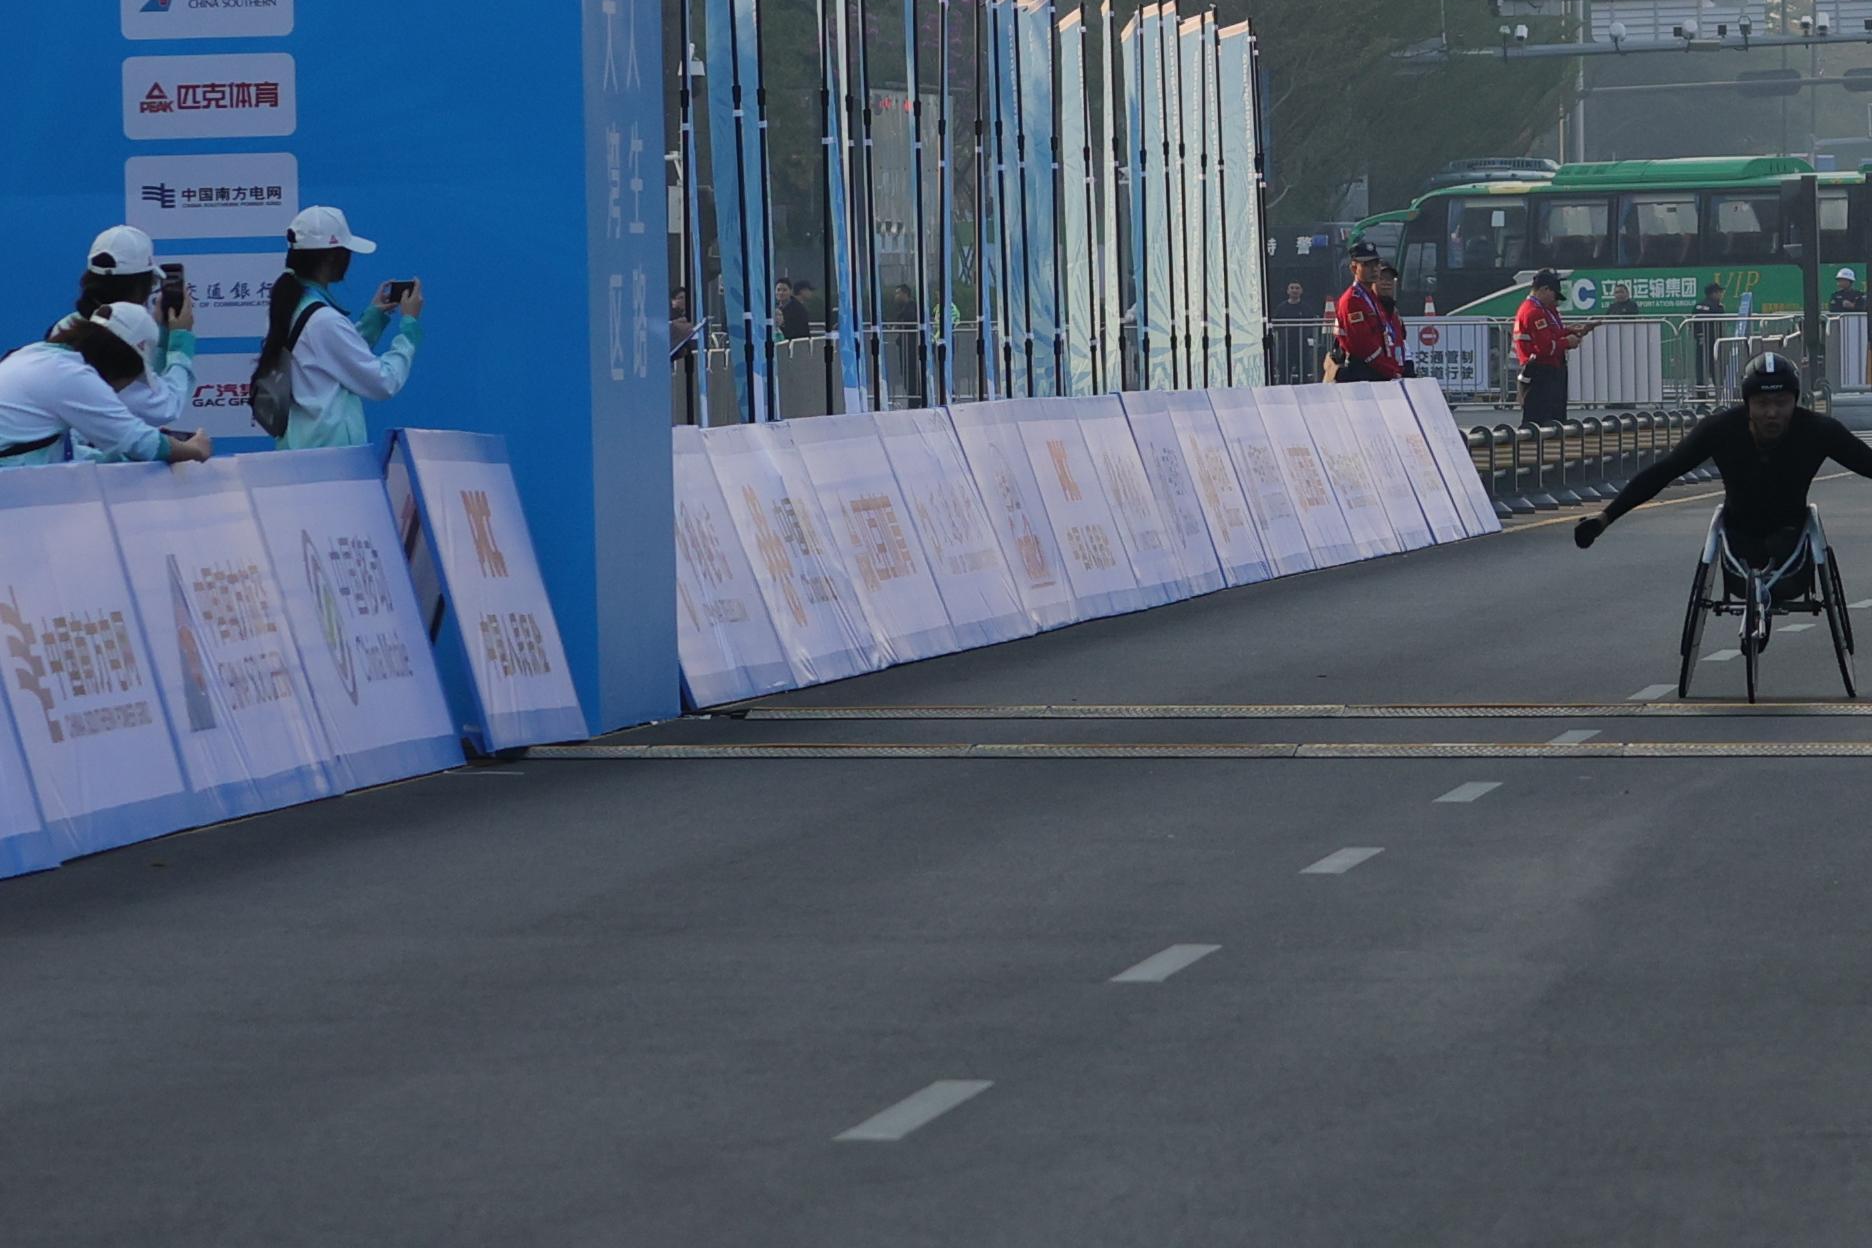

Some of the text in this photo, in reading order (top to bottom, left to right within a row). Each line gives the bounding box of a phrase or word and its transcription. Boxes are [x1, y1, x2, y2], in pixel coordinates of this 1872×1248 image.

[177, 82, 279, 109] 匹克体育
[140, 101, 174, 113] PEAK
[181, 186, 282, 201] 中国南方电网
[1714, 271, 1760, 298] VIP
[193, 398, 226, 408] GAC
